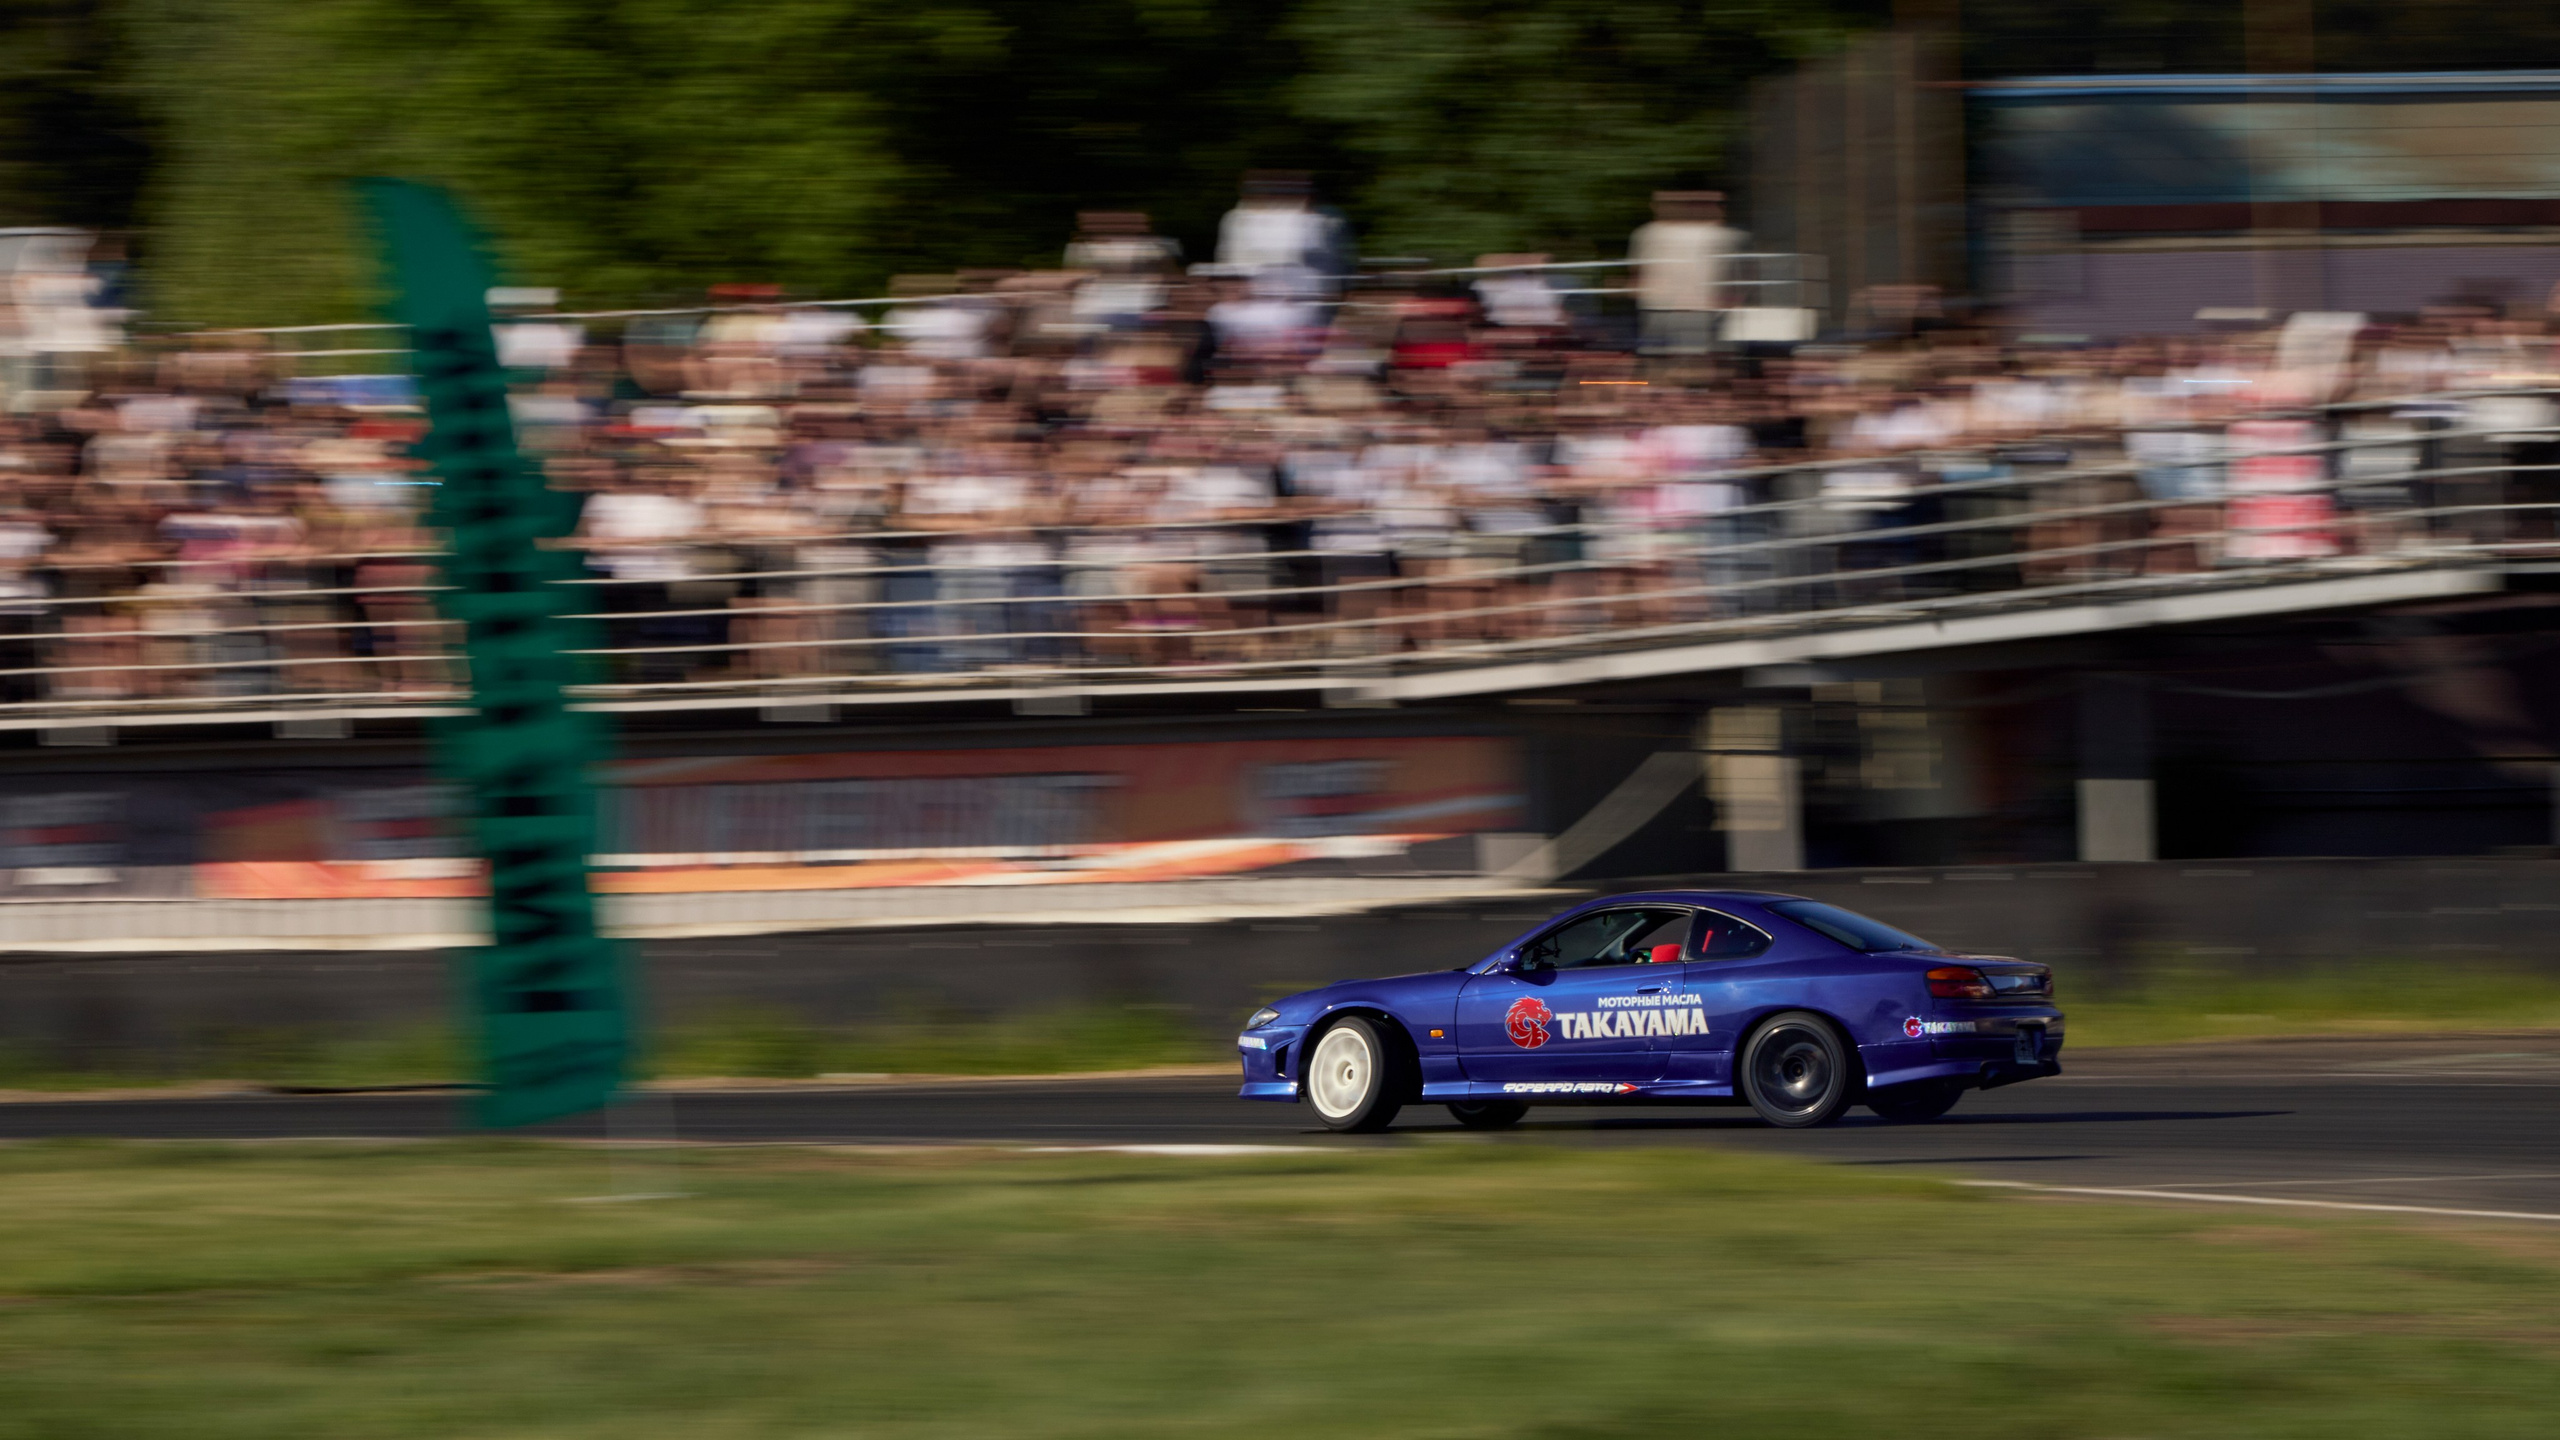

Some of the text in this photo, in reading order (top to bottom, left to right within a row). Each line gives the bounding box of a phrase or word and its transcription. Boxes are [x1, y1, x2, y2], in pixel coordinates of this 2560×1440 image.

[1598, 993, 1703, 1008] МОТОРНЫЕ МАСЛА
[1556, 1008, 1710, 1039] TAKAYAMA
